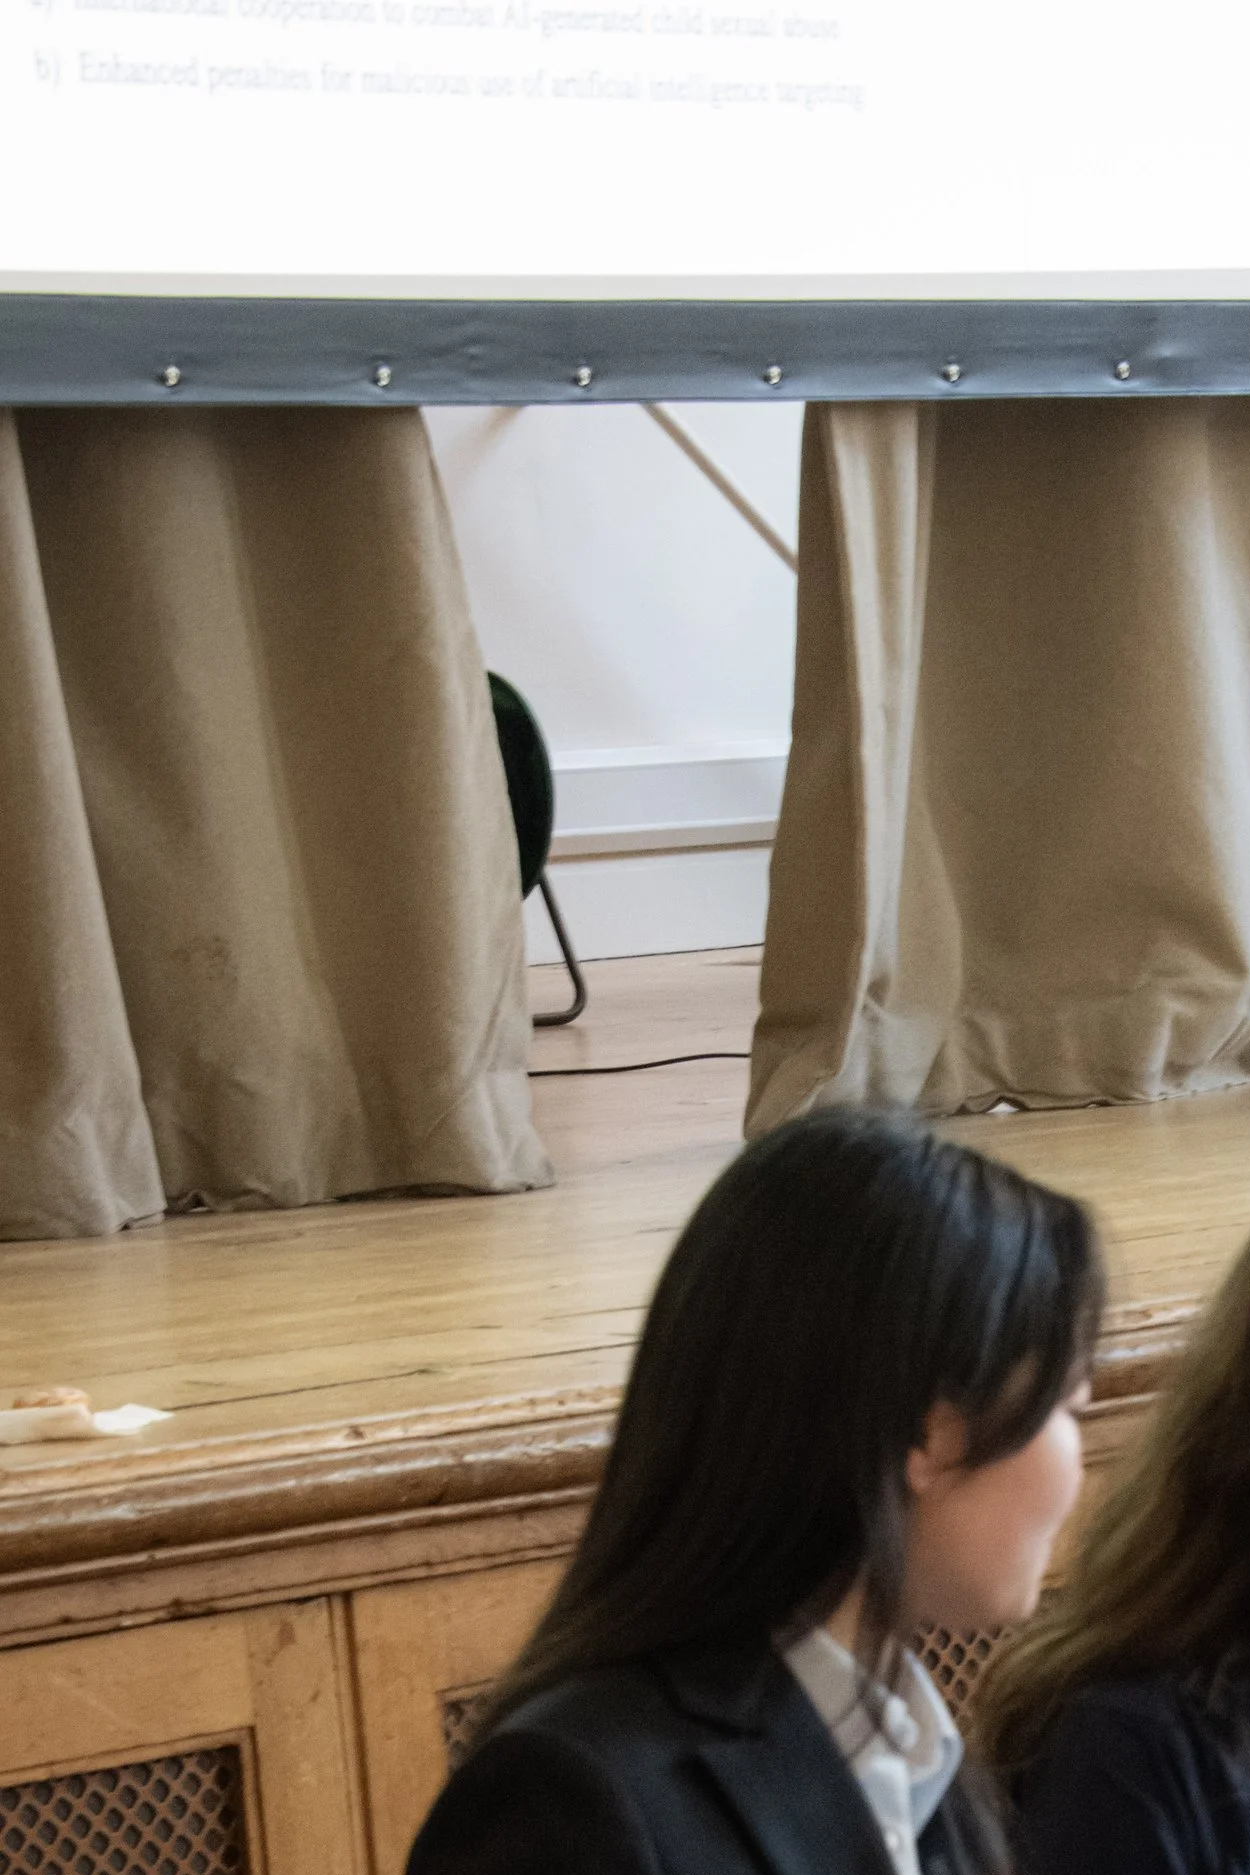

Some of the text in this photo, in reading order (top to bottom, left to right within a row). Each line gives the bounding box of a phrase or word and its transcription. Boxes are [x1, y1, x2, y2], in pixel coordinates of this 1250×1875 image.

[78, 50, 200, 88] Enhanced
[207, 57, 313, 96] penalties
[320, 60, 354, 93] for
